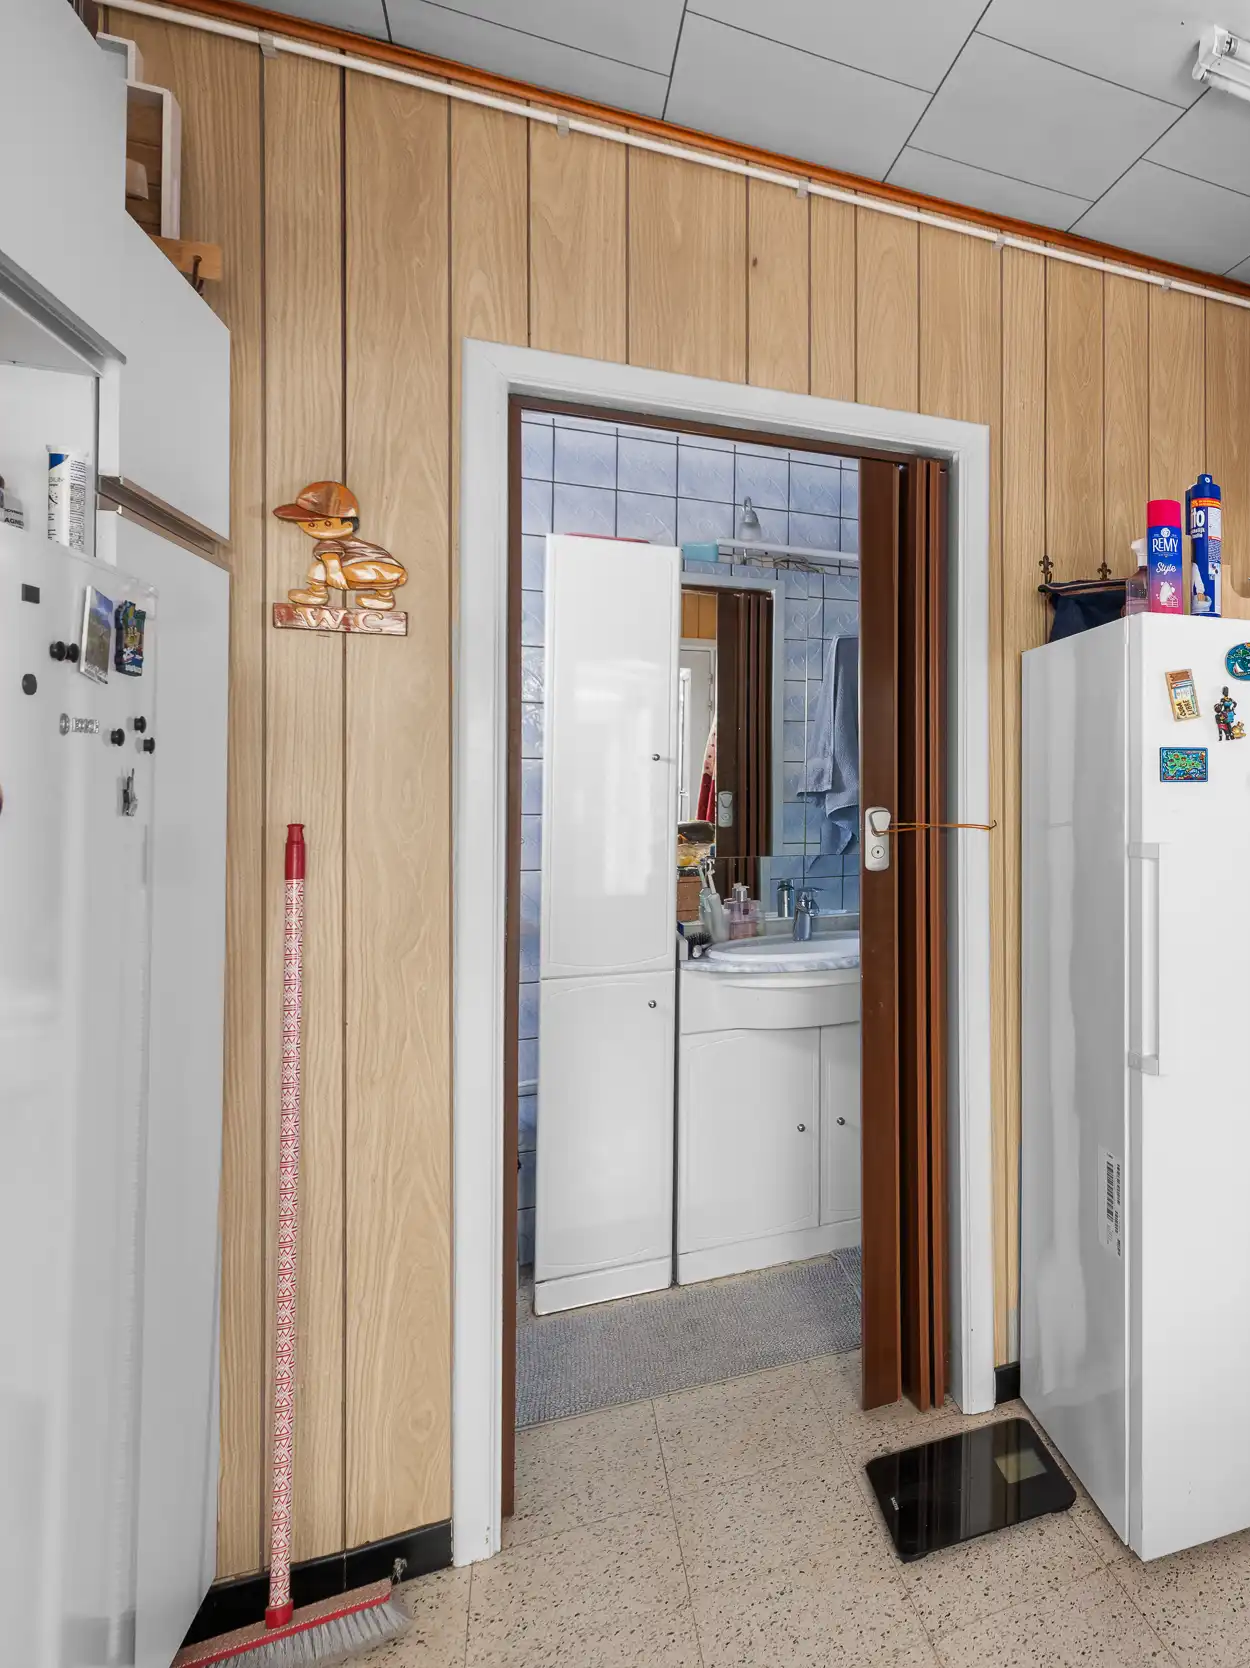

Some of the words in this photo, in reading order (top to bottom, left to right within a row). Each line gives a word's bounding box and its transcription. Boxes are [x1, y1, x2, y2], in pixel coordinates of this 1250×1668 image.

[1152, 537, 1178, 553] REMY
[1156, 562, 1176, 576] Style
[296, 606, 384, 632] WC
